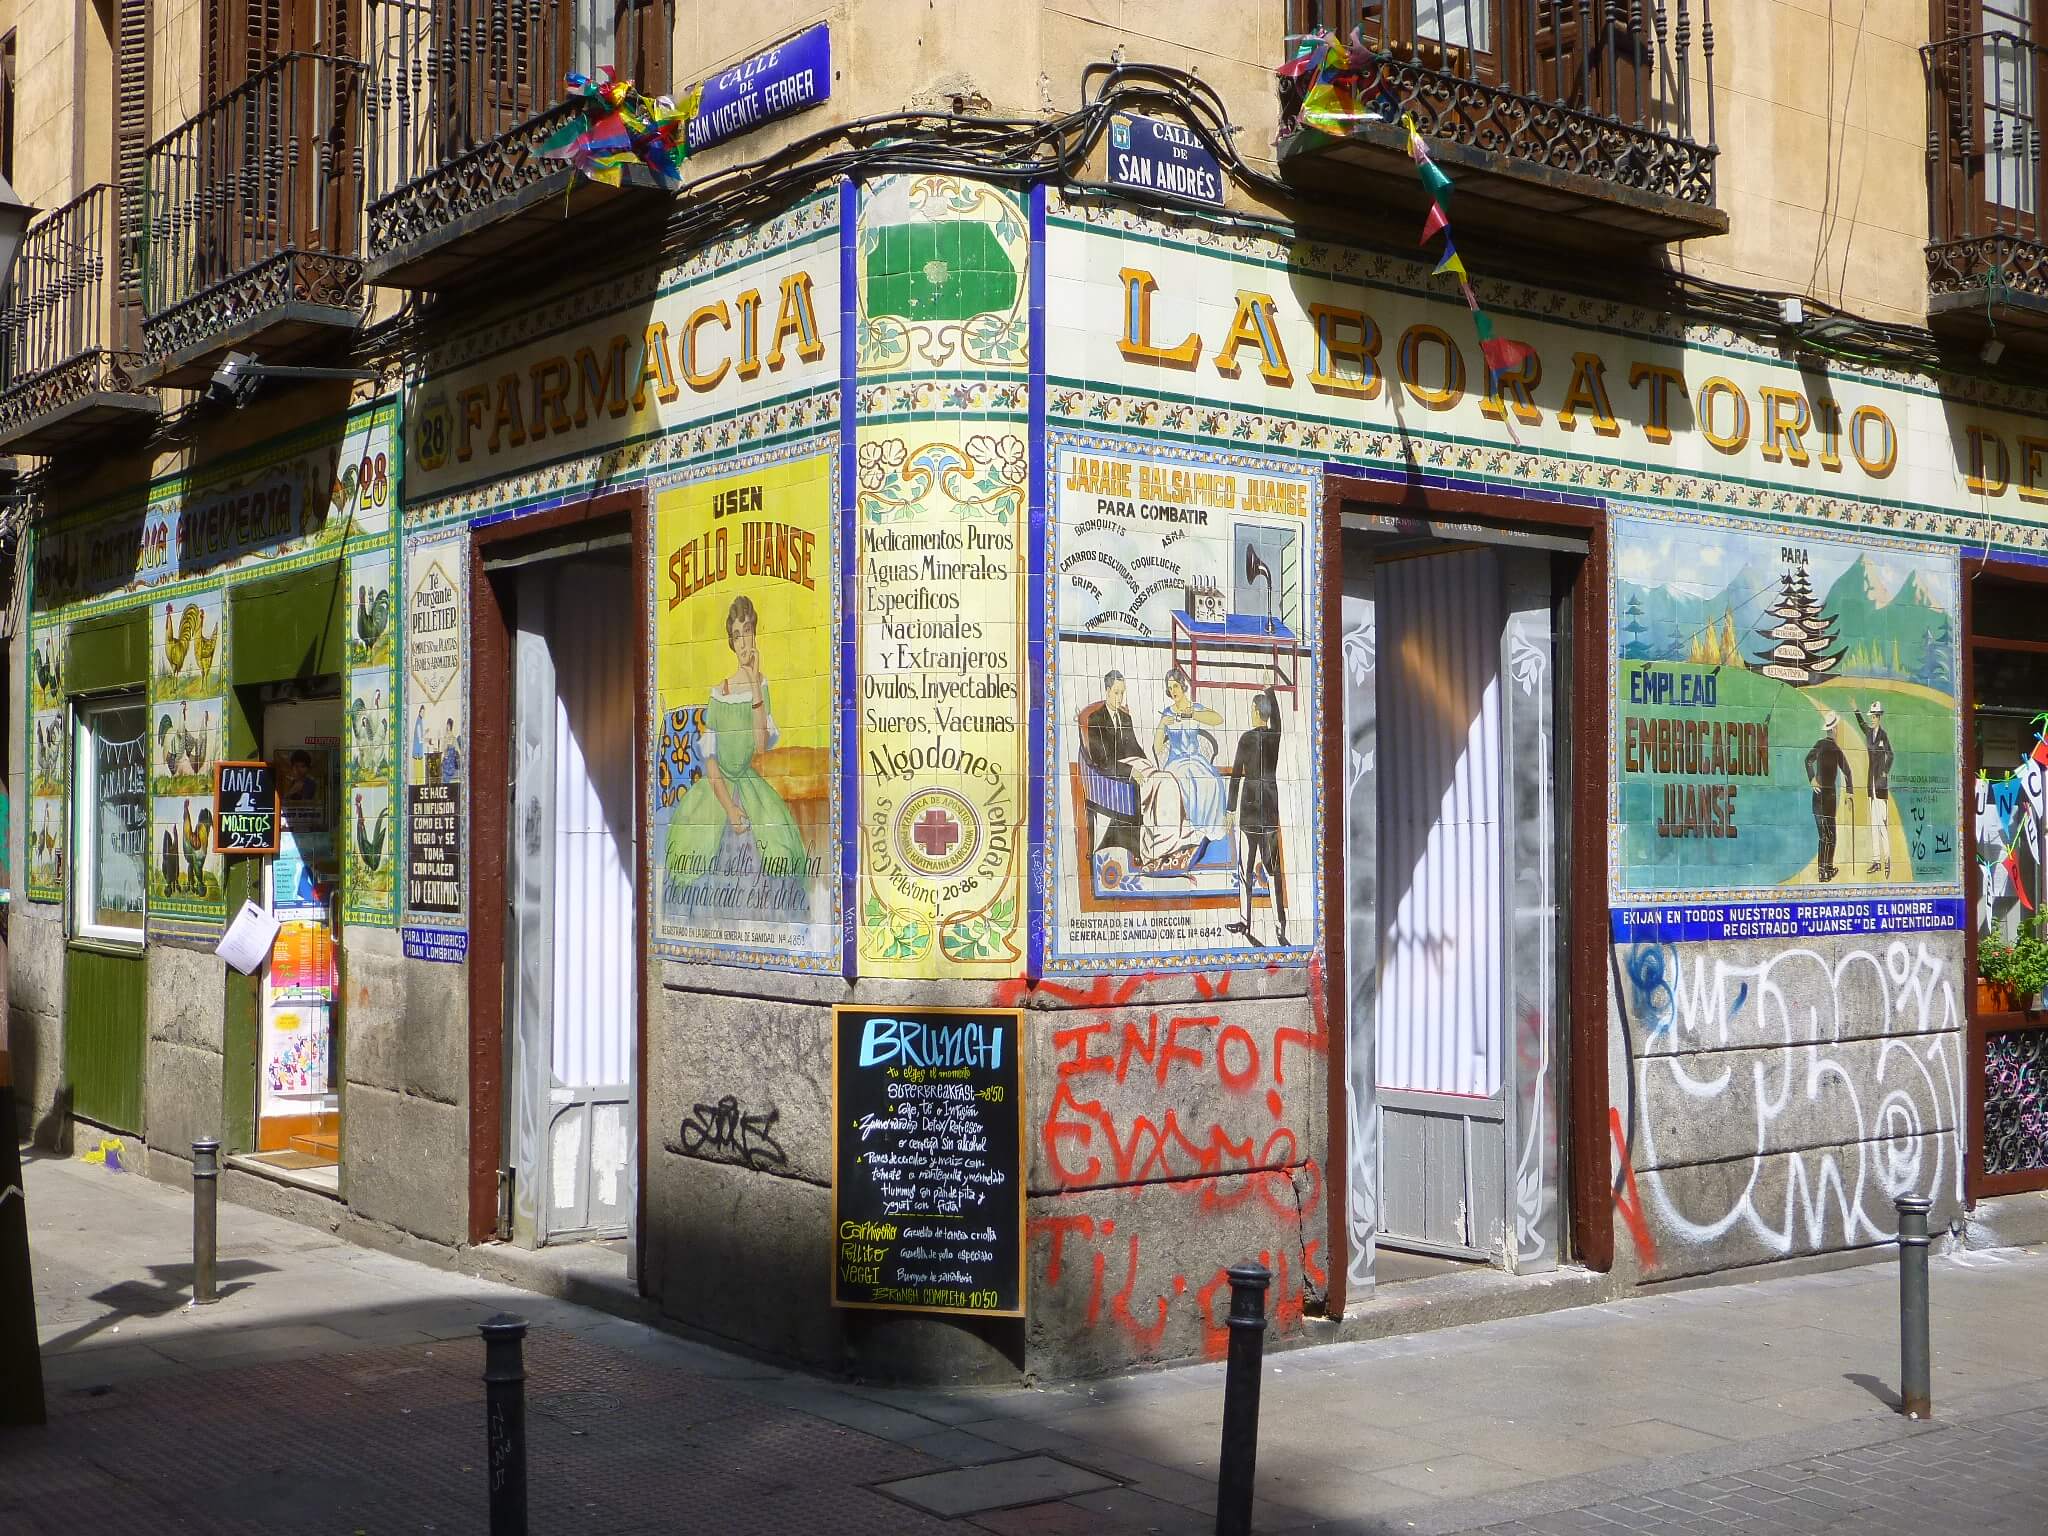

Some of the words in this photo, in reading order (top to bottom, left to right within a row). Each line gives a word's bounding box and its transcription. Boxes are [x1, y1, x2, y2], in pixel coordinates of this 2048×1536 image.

[720, 50, 780, 90] CALLE
[740, 79, 755, 94] DE
[688, 114, 711, 149] SAN
[712, 92, 762, 137] VICENTE
[765, 69, 815, 116] FERRER
[1152, 123, 1205, 150] CALLE
[1173, 146, 1188, 160] DE
[1118, 154, 1152, 186] SAN
[1157, 162, 1217, 199] ANDRÉS
[423, 418, 446, 455] 28
[456, 270, 826, 462] FARMACIA
[1116, 266, 1898, 480] LABORATORIO
[359, 452, 388, 511] 28
[1067, 456, 1132, 498] JARABE
[1139, 465, 1236, 510] BALSAMICO
[1242, 478, 1308, 517] JUANSE
[713, 486, 763, 520] USEN
[1097, 499, 1136, 518] PARA
[1140, 504, 1208, 526] COMBATIR
[864, 528, 963, 553] Medicamentos
[967, 524, 1014, 551] Puros
[1161, 528, 1186, 549] ASMA
[669, 527, 728, 612] SELLO
[735, 522, 816, 592] JUANSE
[1130, 555, 1182, 576] COQUELUCHE
[1781, 546, 1809, 565] PARA
[429, 573, 438, 590] Té
[867, 557, 919, 588] Aguas
[921, 555, 1008, 581] Minerales
[1060, 550, 1097, 573] CATARROS
[1098, 551, 1140, 595] DESCUIDADOS
[417, 587, 452, 609] Purgante
[1129, 591, 1148, 615] TOSES
[1146, 577, 1186, 598] PERTINACES
[412, 606, 457, 635] PELLETIER
[881, 613, 983, 640] Nacionales
[897, 643, 1008, 676] Extranjeros
[864, 674, 919, 700] Ovulos,
[921, 674, 1018, 704] Inyectables
[1630, 669, 1717, 707] EMPLEAD
[866, 708, 932, 734] Sueros,
[934, 706, 1015, 733] Vacunas
[1624, 717, 1769, 777] EMBROCACION
[869, 735, 1002, 787] Algodones
[222, 768, 264, 793] CAÑAS
[420, 787, 429, 800] SE
[430, 786, 448, 799] HACE
[413, 802, 423, 815] EN
[902, 798, 928, 827] FABRICA
[930, 796, 940, 805] DE
[942, 797, 973, 826] APOSITOS
[1657, 783, 1738, 839] JUANSE
[1911, 807, 1925, 822] TU
[222, 813, 271, 833] MOJITOS
[414, 817, 433, 830] COMO
[434, 817, 444, 829] EL
[445, 817, 455, 829] TE
[872, 796, 893, 873] Gasas
[978, 783, 1012, 881] Vendas
[1916, 824, 1923, 839] Y
[413, 832, 436, 845] NEGRO
[445, 832, 455, 845] SE
[1912, 841, 1926, 860] YO
[423, 848, 445, 861] TOMA
[708, 843, 723, 875] al
[724, 842, 753, 877] sello
[804, 840, 822, 878] ha
[413, 863, 428, 876] CON
[428, 862, 454, 876] PLACER
[410, 879, 420, 904] 10
[423, 880, 460, 906] CENTIMOS
[664, 875, 745, 916] desaparecido
[889, 865, 940, 905] Telefono
[942, 876, 979, 902] 20-86
[1070, 917, 1121, 929] REGISTRADO
[1123, 918, 1134, 928] EN
[1136, 918, 1148, 928] LA
[1150, 916, 1191, 928] DIRECCION
[1623, 908, 1663, 925] EXIJAN
[1667, 910, 1681, 923] EN
[1686, 908, 1724, 923] TODOS
[1729, 907, 1791, 922] NUESTROS
[1797, 904, 1871, 919] PREPARADOS
[1877, 903, 1890, 915] EL
[1891, 902, 1933, 915] NOMBRE
[1723, 921, 1798, 937] REGISTRADO
[1802, 918, 1862, 934] "JUANSE"
[1863, 917, 1876, 930] DE
[1880, 915, 1955, 930] AUTENTICIDAD
[421, 931, 433, 945] LAS
[433, 933, 466, 949] LOMBRICES
[1069, 930, 1109, 942] GENERAL
[1110, 931, 1120, 941] DE
[1122, 930, 1157, 941] SANIDAD
[1160, 929, 1176, 940] CON
[1177, 929, 1187, 940] EL
[859, 1018, 1004, 1069] BRUNCH
[871, 1166, 902, 1181] tomate
[882, 1197, 913, 1216] yogurt
[937, 1199, 959, 1215] fruta
[958, 1184, 976, 1209] pita
